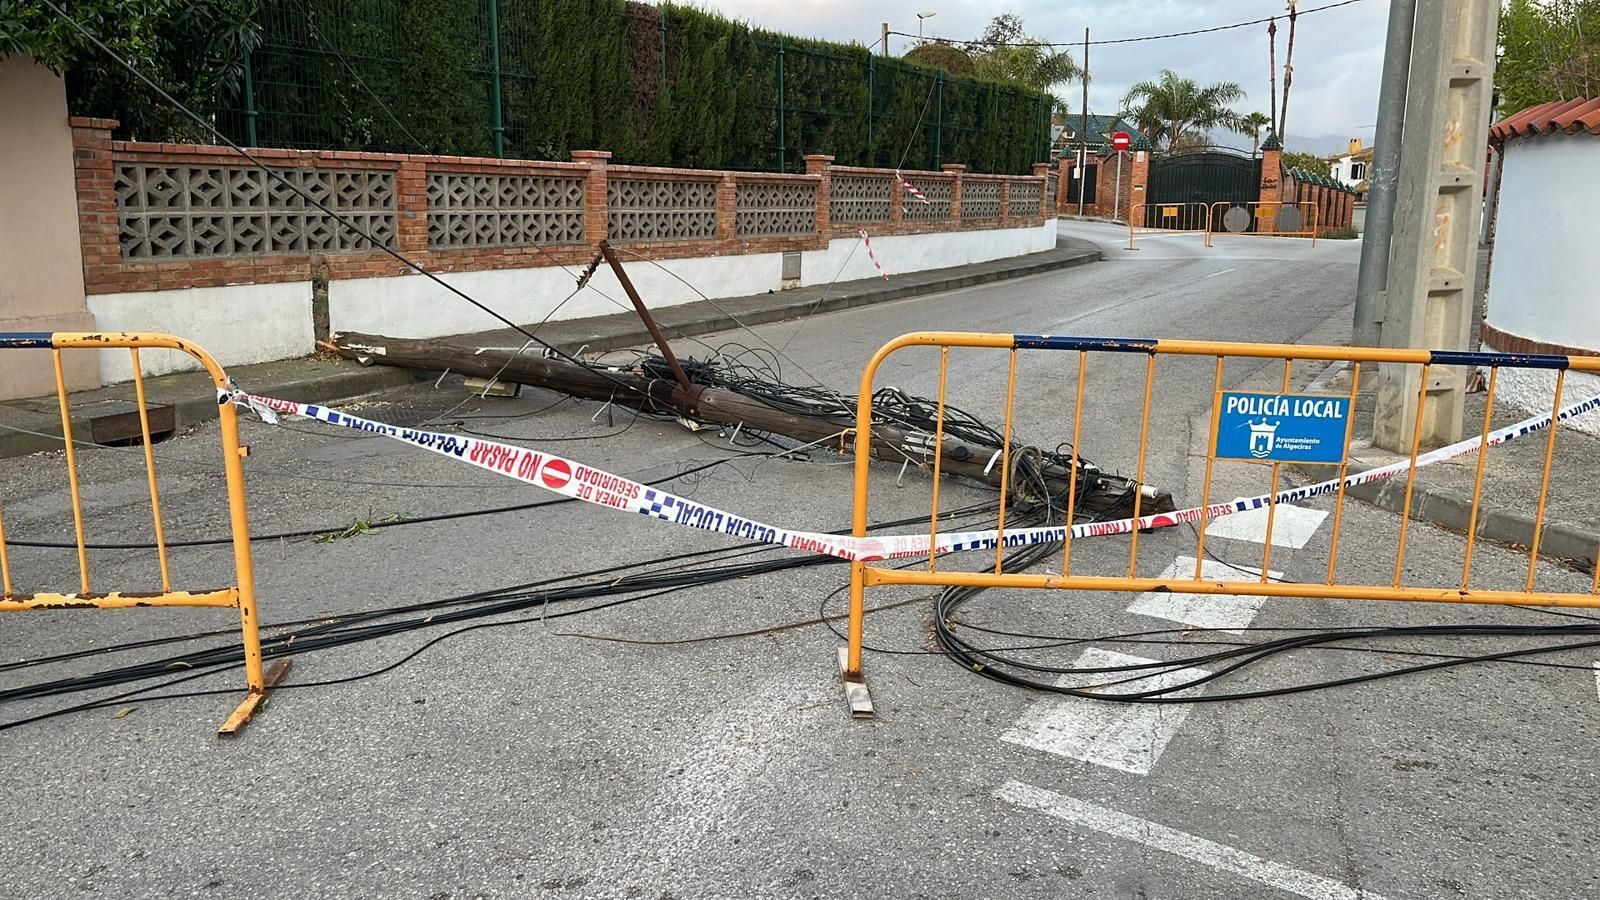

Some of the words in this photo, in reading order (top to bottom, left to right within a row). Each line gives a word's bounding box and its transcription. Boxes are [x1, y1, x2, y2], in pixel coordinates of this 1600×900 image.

[1227, 396, 1289, 417] POLICÍA
[1294, 399, 1343, 418] LOCAL
[1276, 436, 1320, 446] Ayuntamiento
[470, 441, 519, 473] PASAR
[518, 451, 542, 481] NO
[574, 466, 641, 499] SEGURIDAD
[575, 483, 593, 500] DE
[596, 490, 629, 509] LINEA
[674, 500, 723, 532] LOCAL
